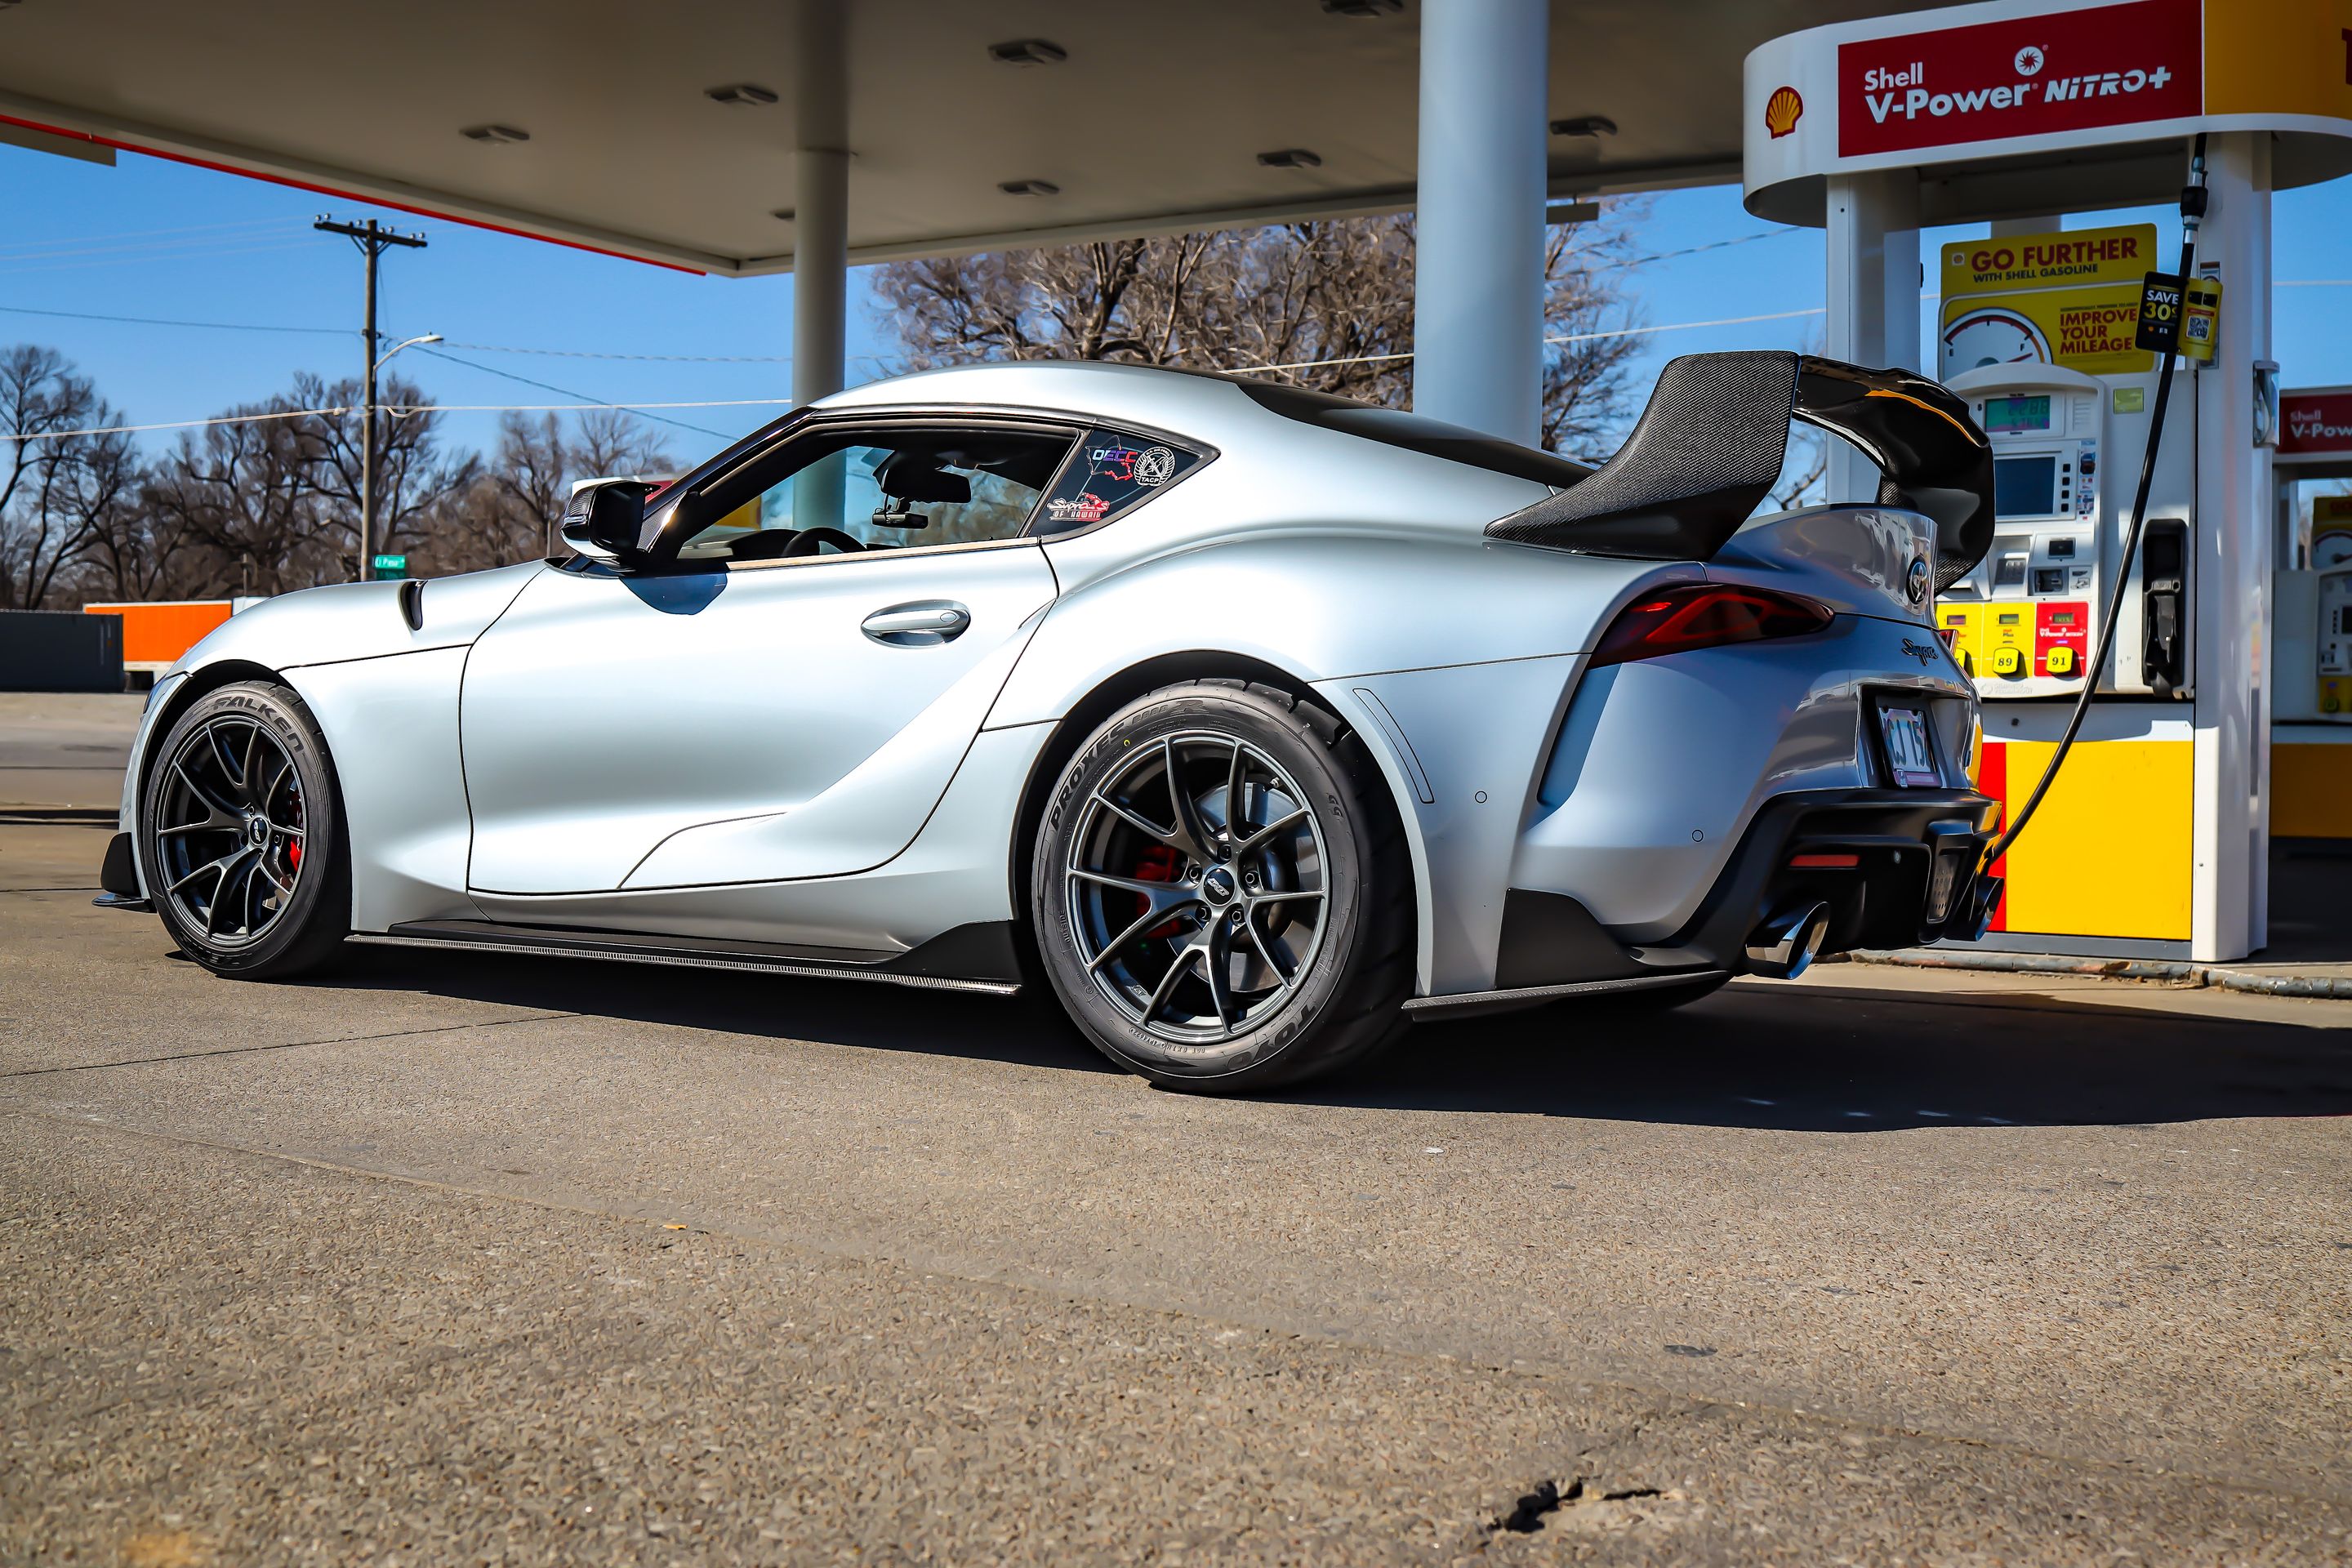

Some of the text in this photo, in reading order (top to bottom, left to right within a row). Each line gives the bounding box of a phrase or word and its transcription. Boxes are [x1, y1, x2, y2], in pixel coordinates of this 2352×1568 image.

[1864, 61, 1923, 91] Shell
[1865, 82, 2030, 123] V-Power
[1971, 237, 2138, 272] GO FURTHER
[1973, 263, 2098, 283] WITH SHELL GASOLINE
[2146, 289, 2179, 305] SAVE
[2060, 309, 2137, 327] IMPROVE
[2060, 325, 2108, 340] YOUR
[2060, 337, 2132, 354] MILEAGE
[2290, 409, 2321, 421] Shell
[1998, 657, 2012, 666] 89
[2051, 657, 2066, 666] 91
[211, 696, 305, 752] FALKEN
[1050, 722, 1125, 831] PROXES
[1227, 1004, 1316, 1071] TOYO
